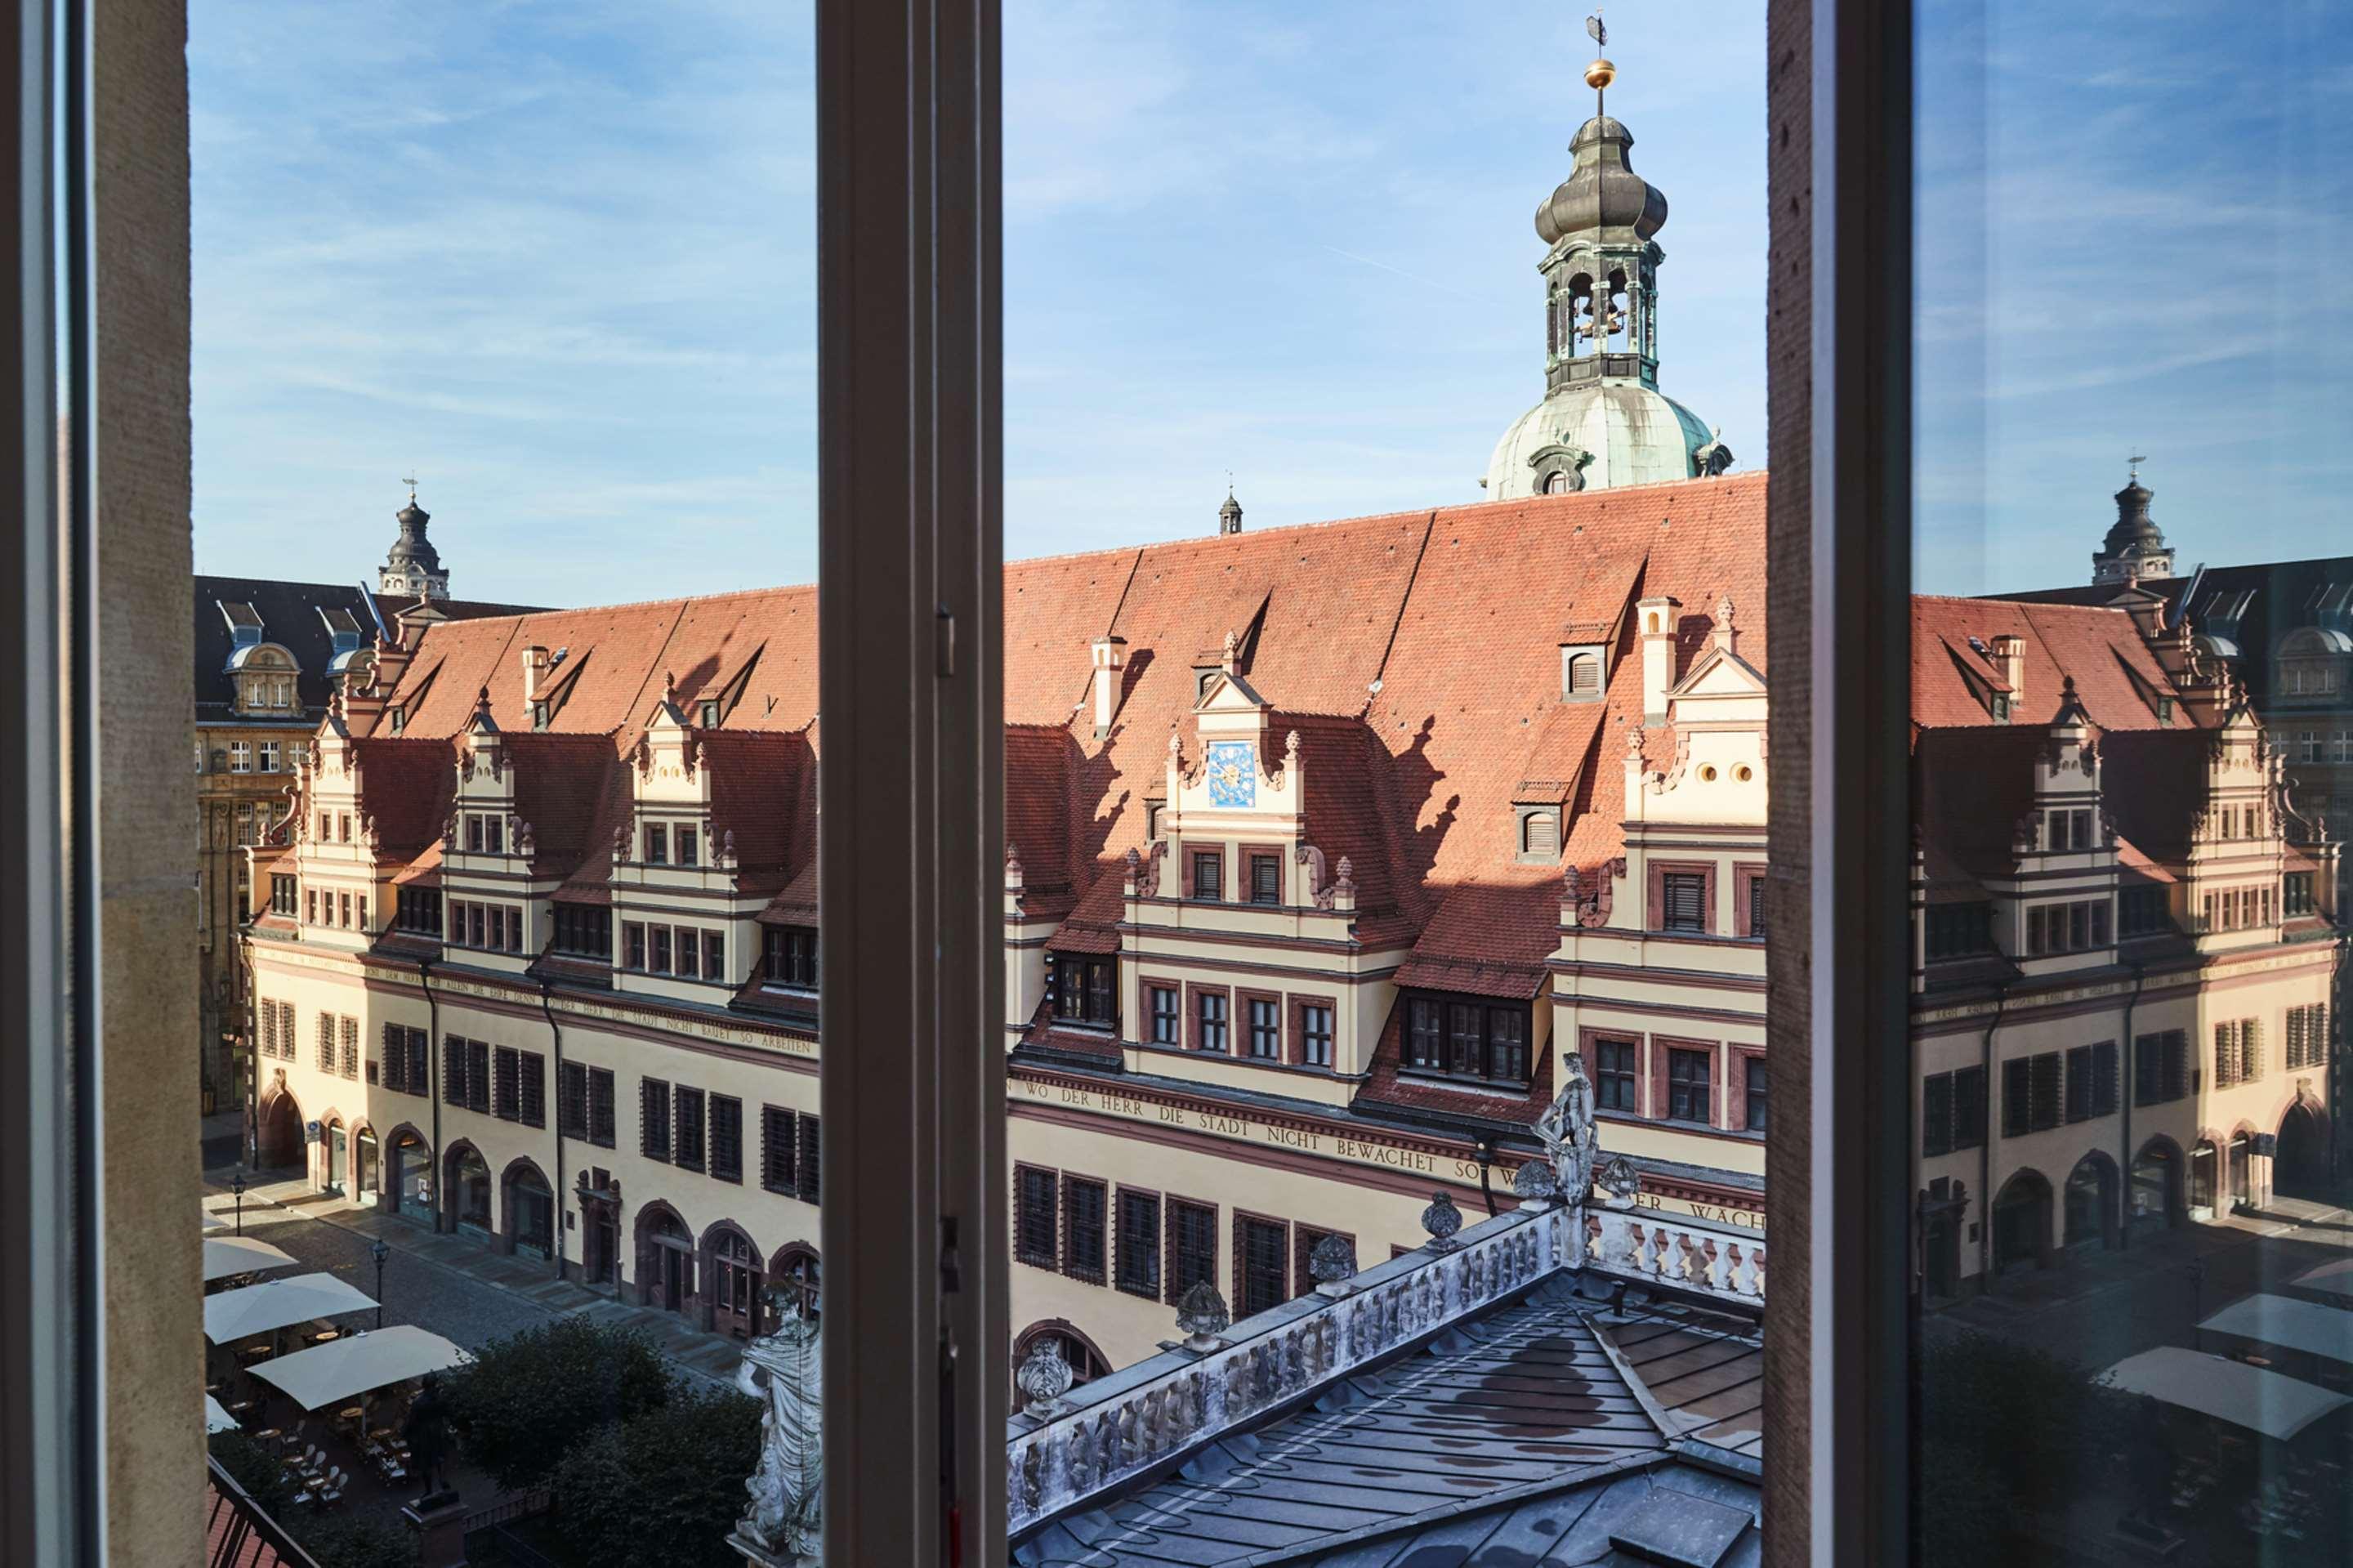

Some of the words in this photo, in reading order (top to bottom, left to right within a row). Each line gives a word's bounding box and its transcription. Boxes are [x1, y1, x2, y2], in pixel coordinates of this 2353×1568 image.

[666, 1018, 694, 1034] NICHT
[701, 1025, 732, 1040] BAUET
[739, 1032, 753, 1043] SO
[761, 1035, 811, 1054] ARBEITEN
[1025, 1083, 1048, 1099] WO
[1062, 1089, 1091, 1106] DER
[1101, 1096, 1143, 1116] HERR
[1159, 1106, 1185, 1124] DIE
[1199, 1114, 1250, 1137] STADT
[1267, 1127, 1320, 1150] NICHT
[1337, 1139, 1437, 1172] BEWACHET
[1454, 1161, 1480, 1181] SO
